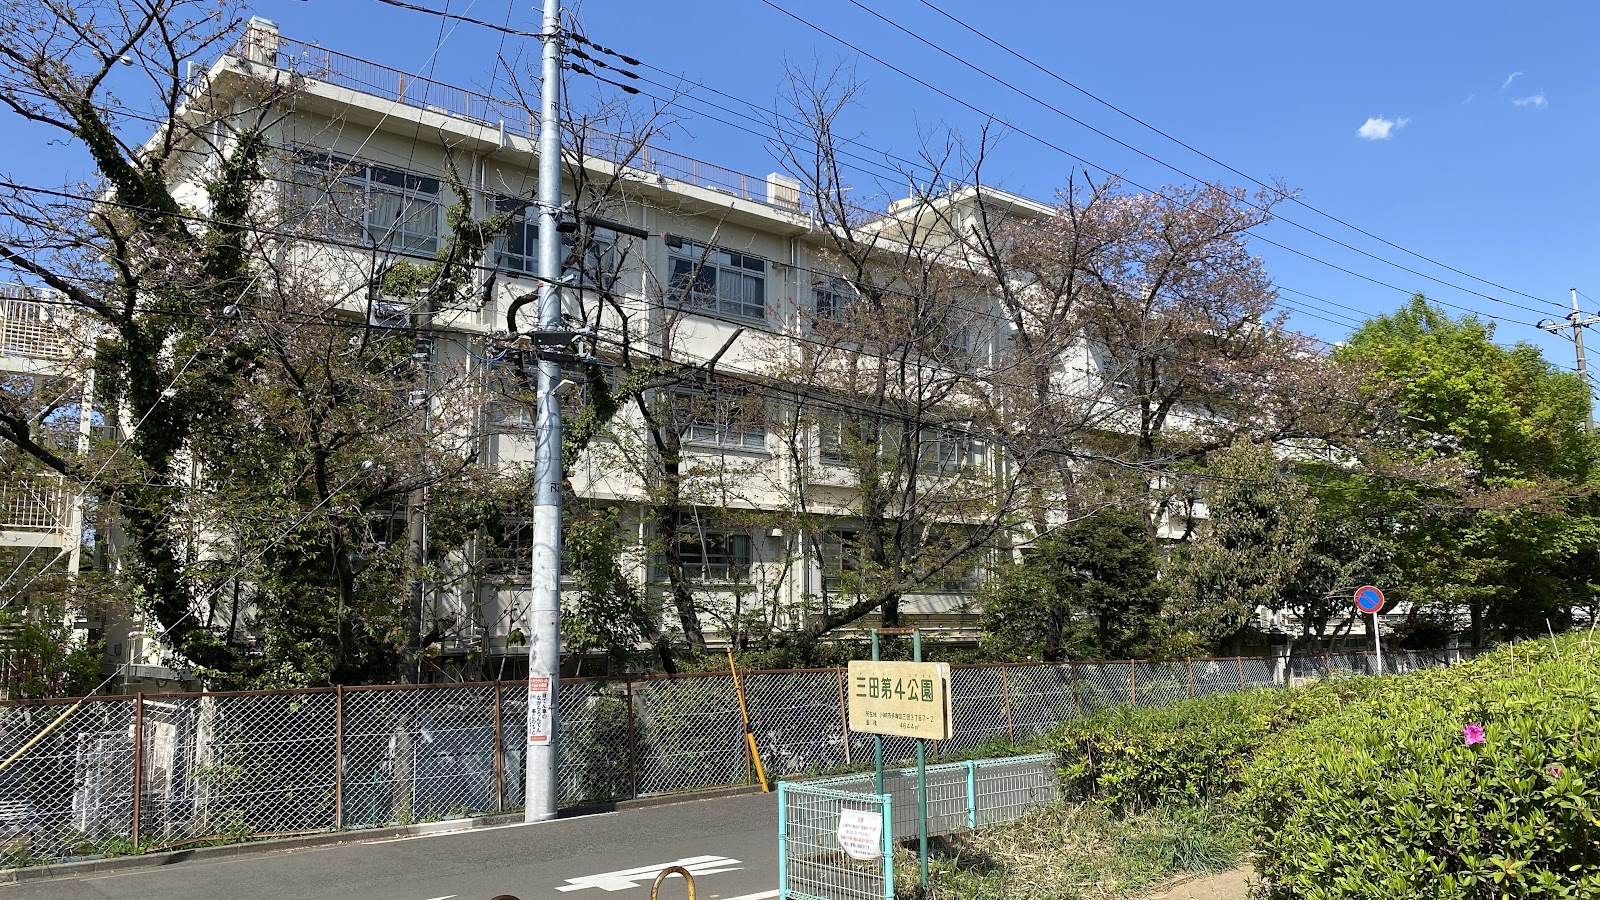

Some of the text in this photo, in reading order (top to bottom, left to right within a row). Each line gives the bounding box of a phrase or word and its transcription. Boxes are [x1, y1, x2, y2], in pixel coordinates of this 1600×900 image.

[856, 677, 934, 702] 三田第4公園
